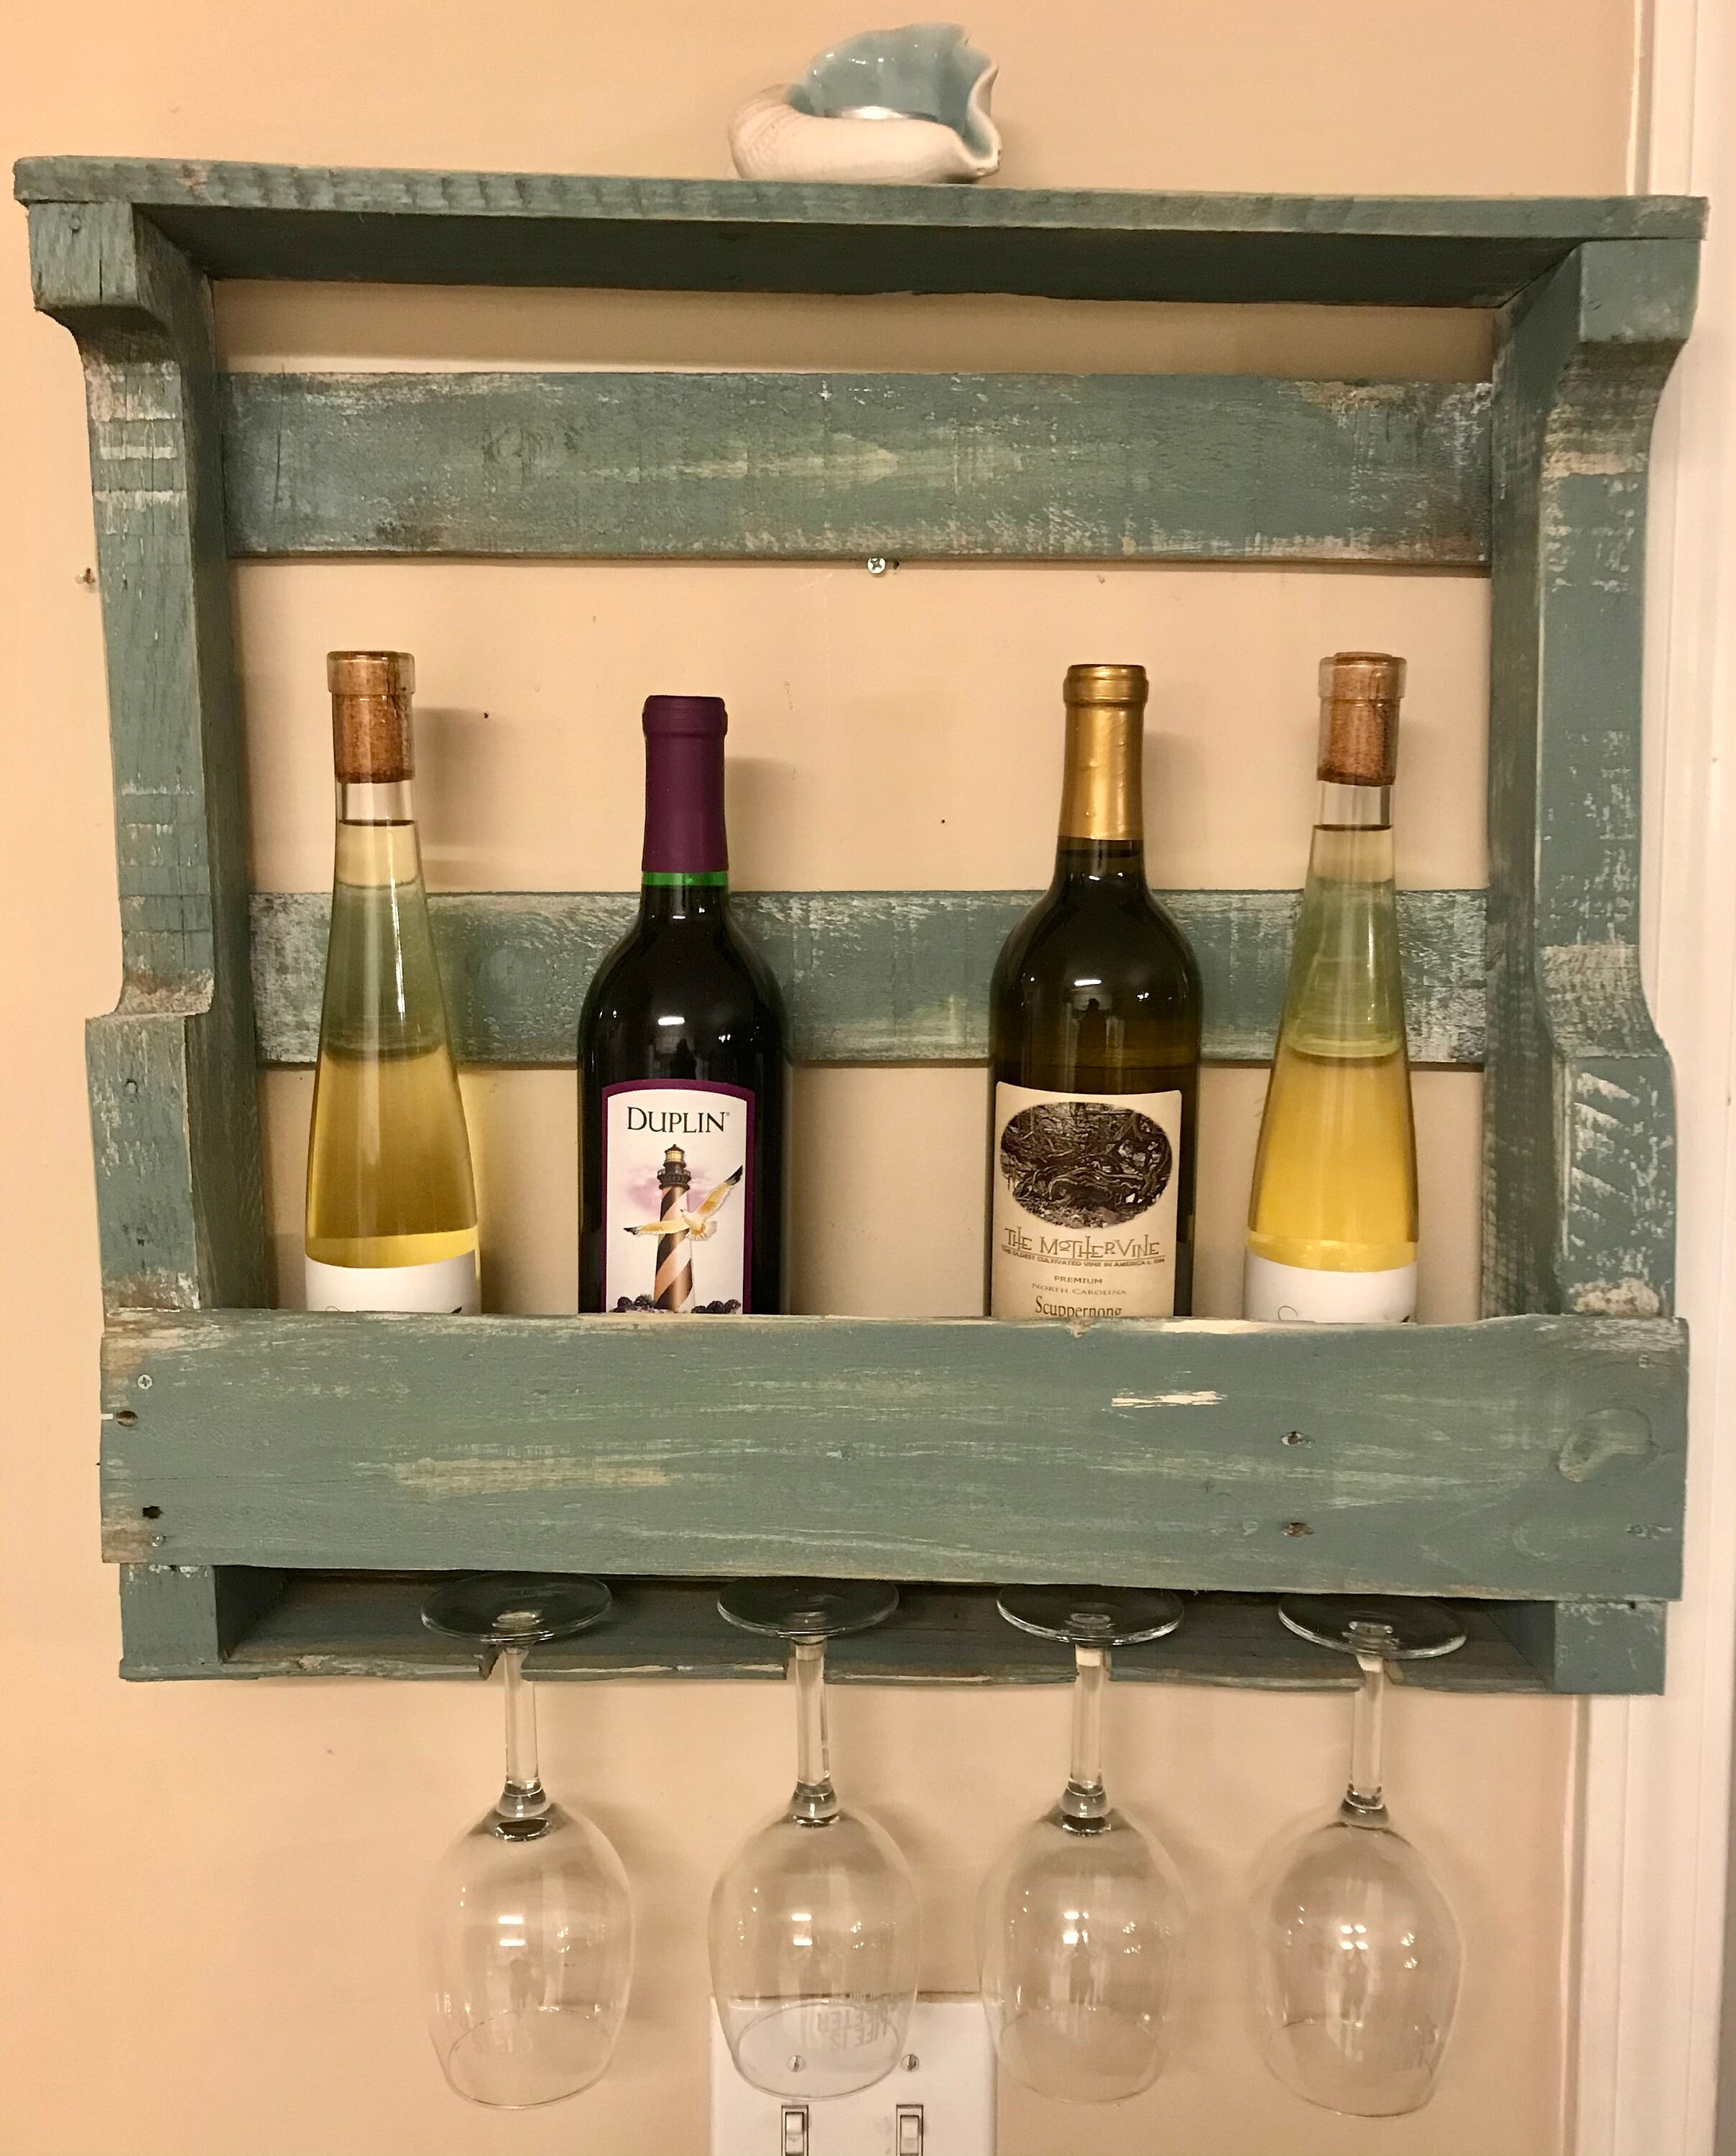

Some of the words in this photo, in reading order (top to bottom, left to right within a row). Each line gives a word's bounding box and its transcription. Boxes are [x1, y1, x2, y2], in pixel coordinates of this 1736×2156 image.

[627, 1106, 726, 1133] DUPLIN
[1005, 1226, 1033, 1250] THE
[1012, 1250, 1035, 1261] OLDEST
[1037, 1256, 1081, 1266] CULTIVATED
[1032, 1283, 1068, 1294] NORTH
[1054, 1275, 1103, 1284] PREMIUM
[1035, 1295, 1122, 1317] Scuppernong
